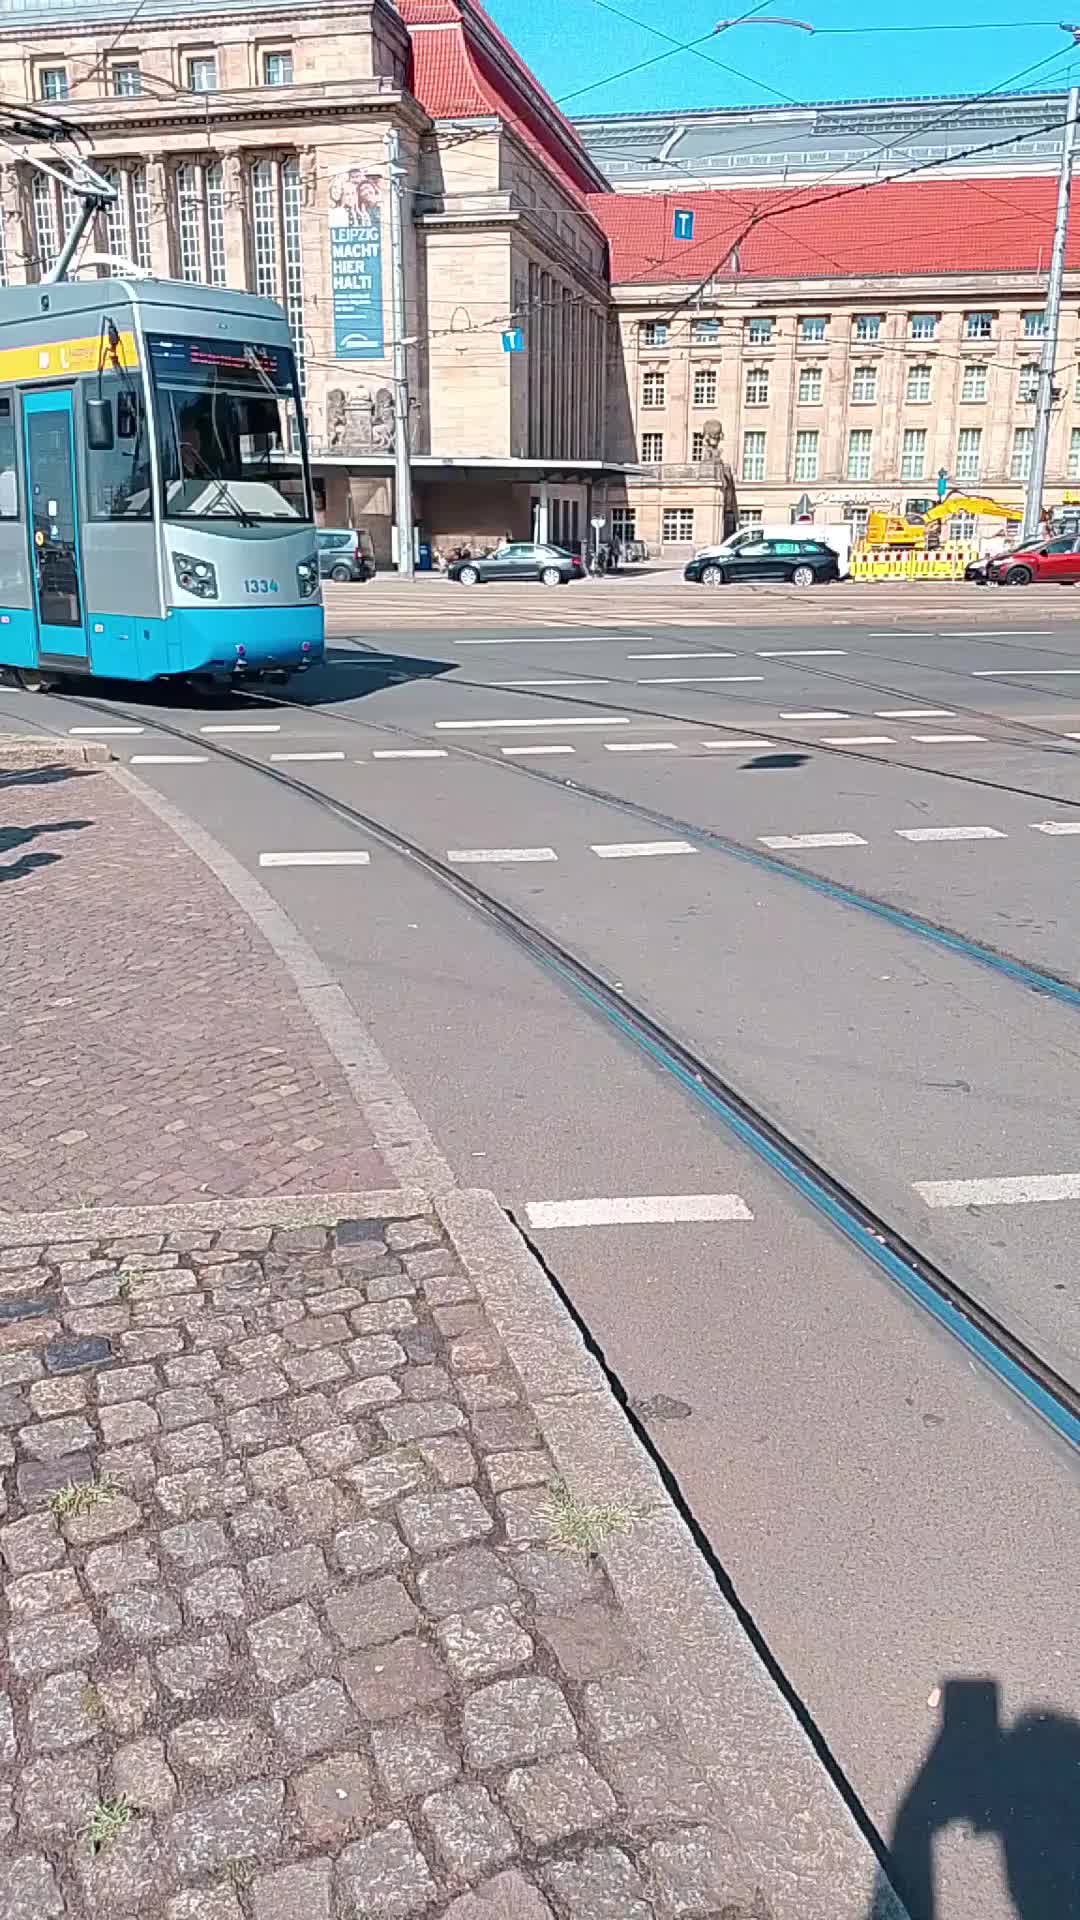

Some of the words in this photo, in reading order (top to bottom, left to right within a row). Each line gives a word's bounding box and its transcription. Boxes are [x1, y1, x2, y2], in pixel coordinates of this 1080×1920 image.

[331, 227, 379, 242] LEIPZIG
[332, 243, 379, 258] MACHT
[333, 260, 365, 274] HIER
[244, 578, 278, 593] 1334
